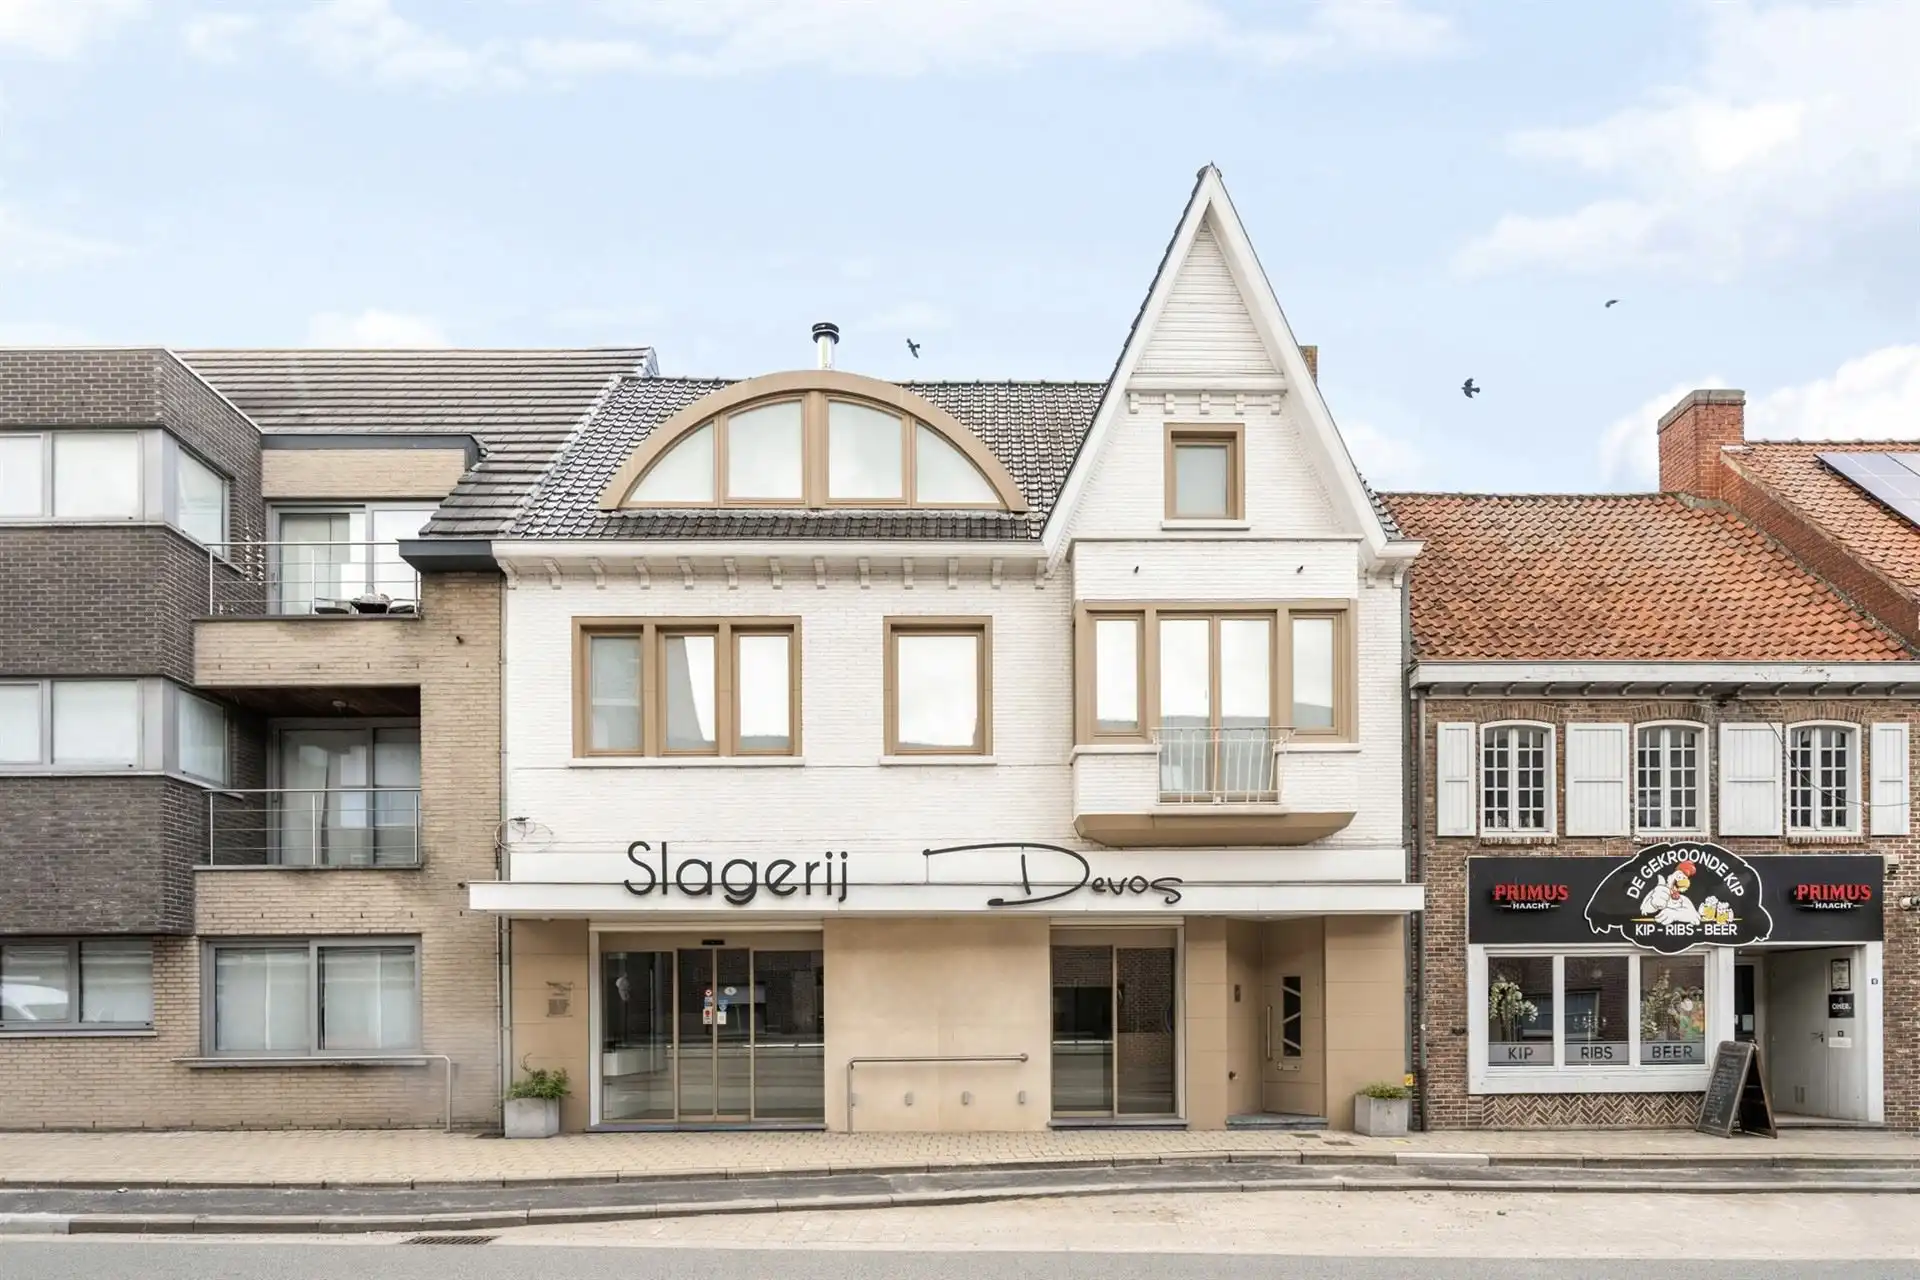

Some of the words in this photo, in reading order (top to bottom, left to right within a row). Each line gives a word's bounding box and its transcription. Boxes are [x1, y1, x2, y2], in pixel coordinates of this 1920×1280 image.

[623, 840, 849, 906] Slagerij
[922, 842, 1184, 905] Devos
[1626, 876, 1646, 899] DE
[1641, 848, 1729, 880] GEKROONDE
[1723, 872, 1745, 898] KIP
[1494, 884, 1570, 901] PRIMUS
[1796, 884, 1872, 901] PRIMUS
[1635, 924, 1655, 936] KIP
[1665, 924, 1694, 936] RIBS
[1704, 924, 1738, 936] BEER
[1508, 1047, 1534, 1060] KIP
[1580, 1046, 1613, 1060] RIBS
[1652, 1045, 1693, 1059] BEER
